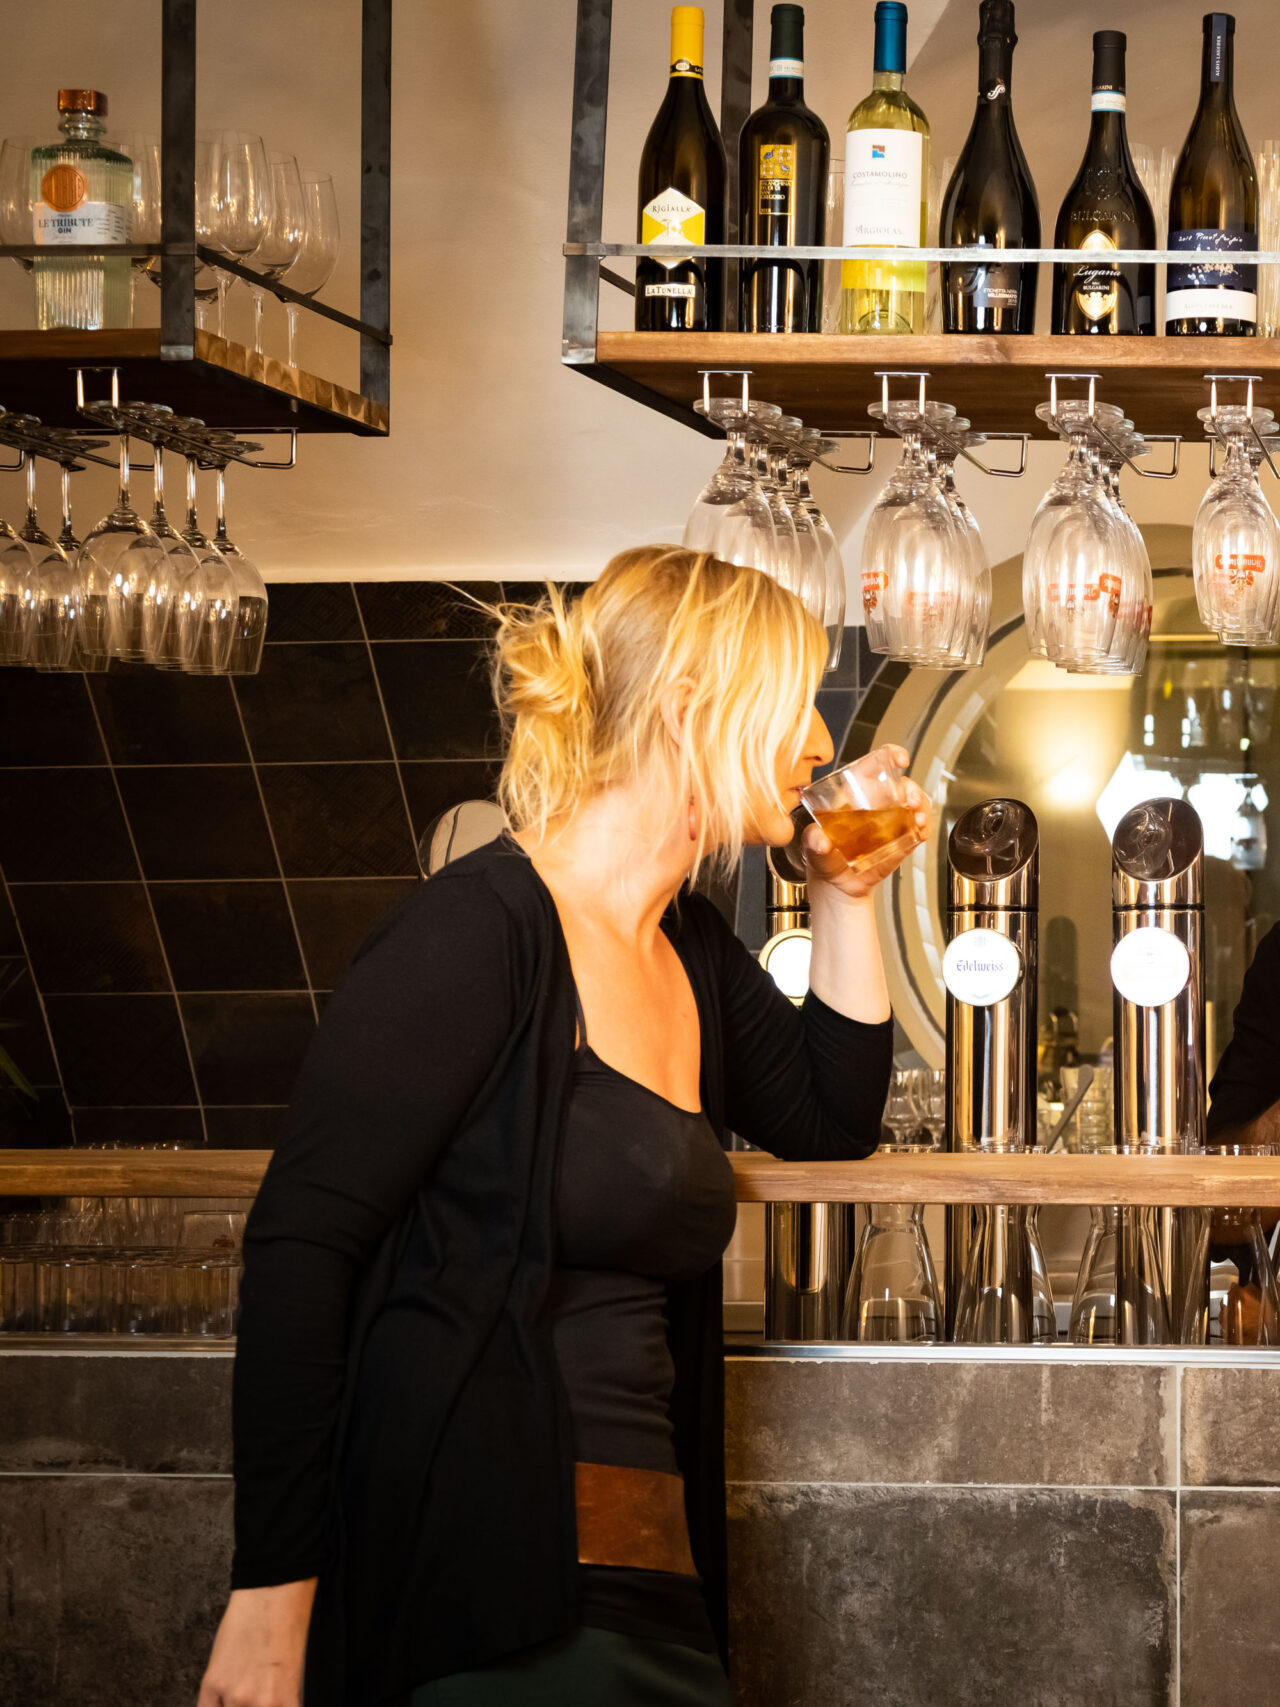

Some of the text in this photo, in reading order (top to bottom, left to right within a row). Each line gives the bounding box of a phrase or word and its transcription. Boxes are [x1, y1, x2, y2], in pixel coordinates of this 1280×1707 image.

[852, 170, 908, 179] COSTAMOLINO
[50, 217, 94, 227] TRIBUTE
[1072, 264, 1121, 284] Lugana
[956, 959, 1004, 972] Edelweiss
